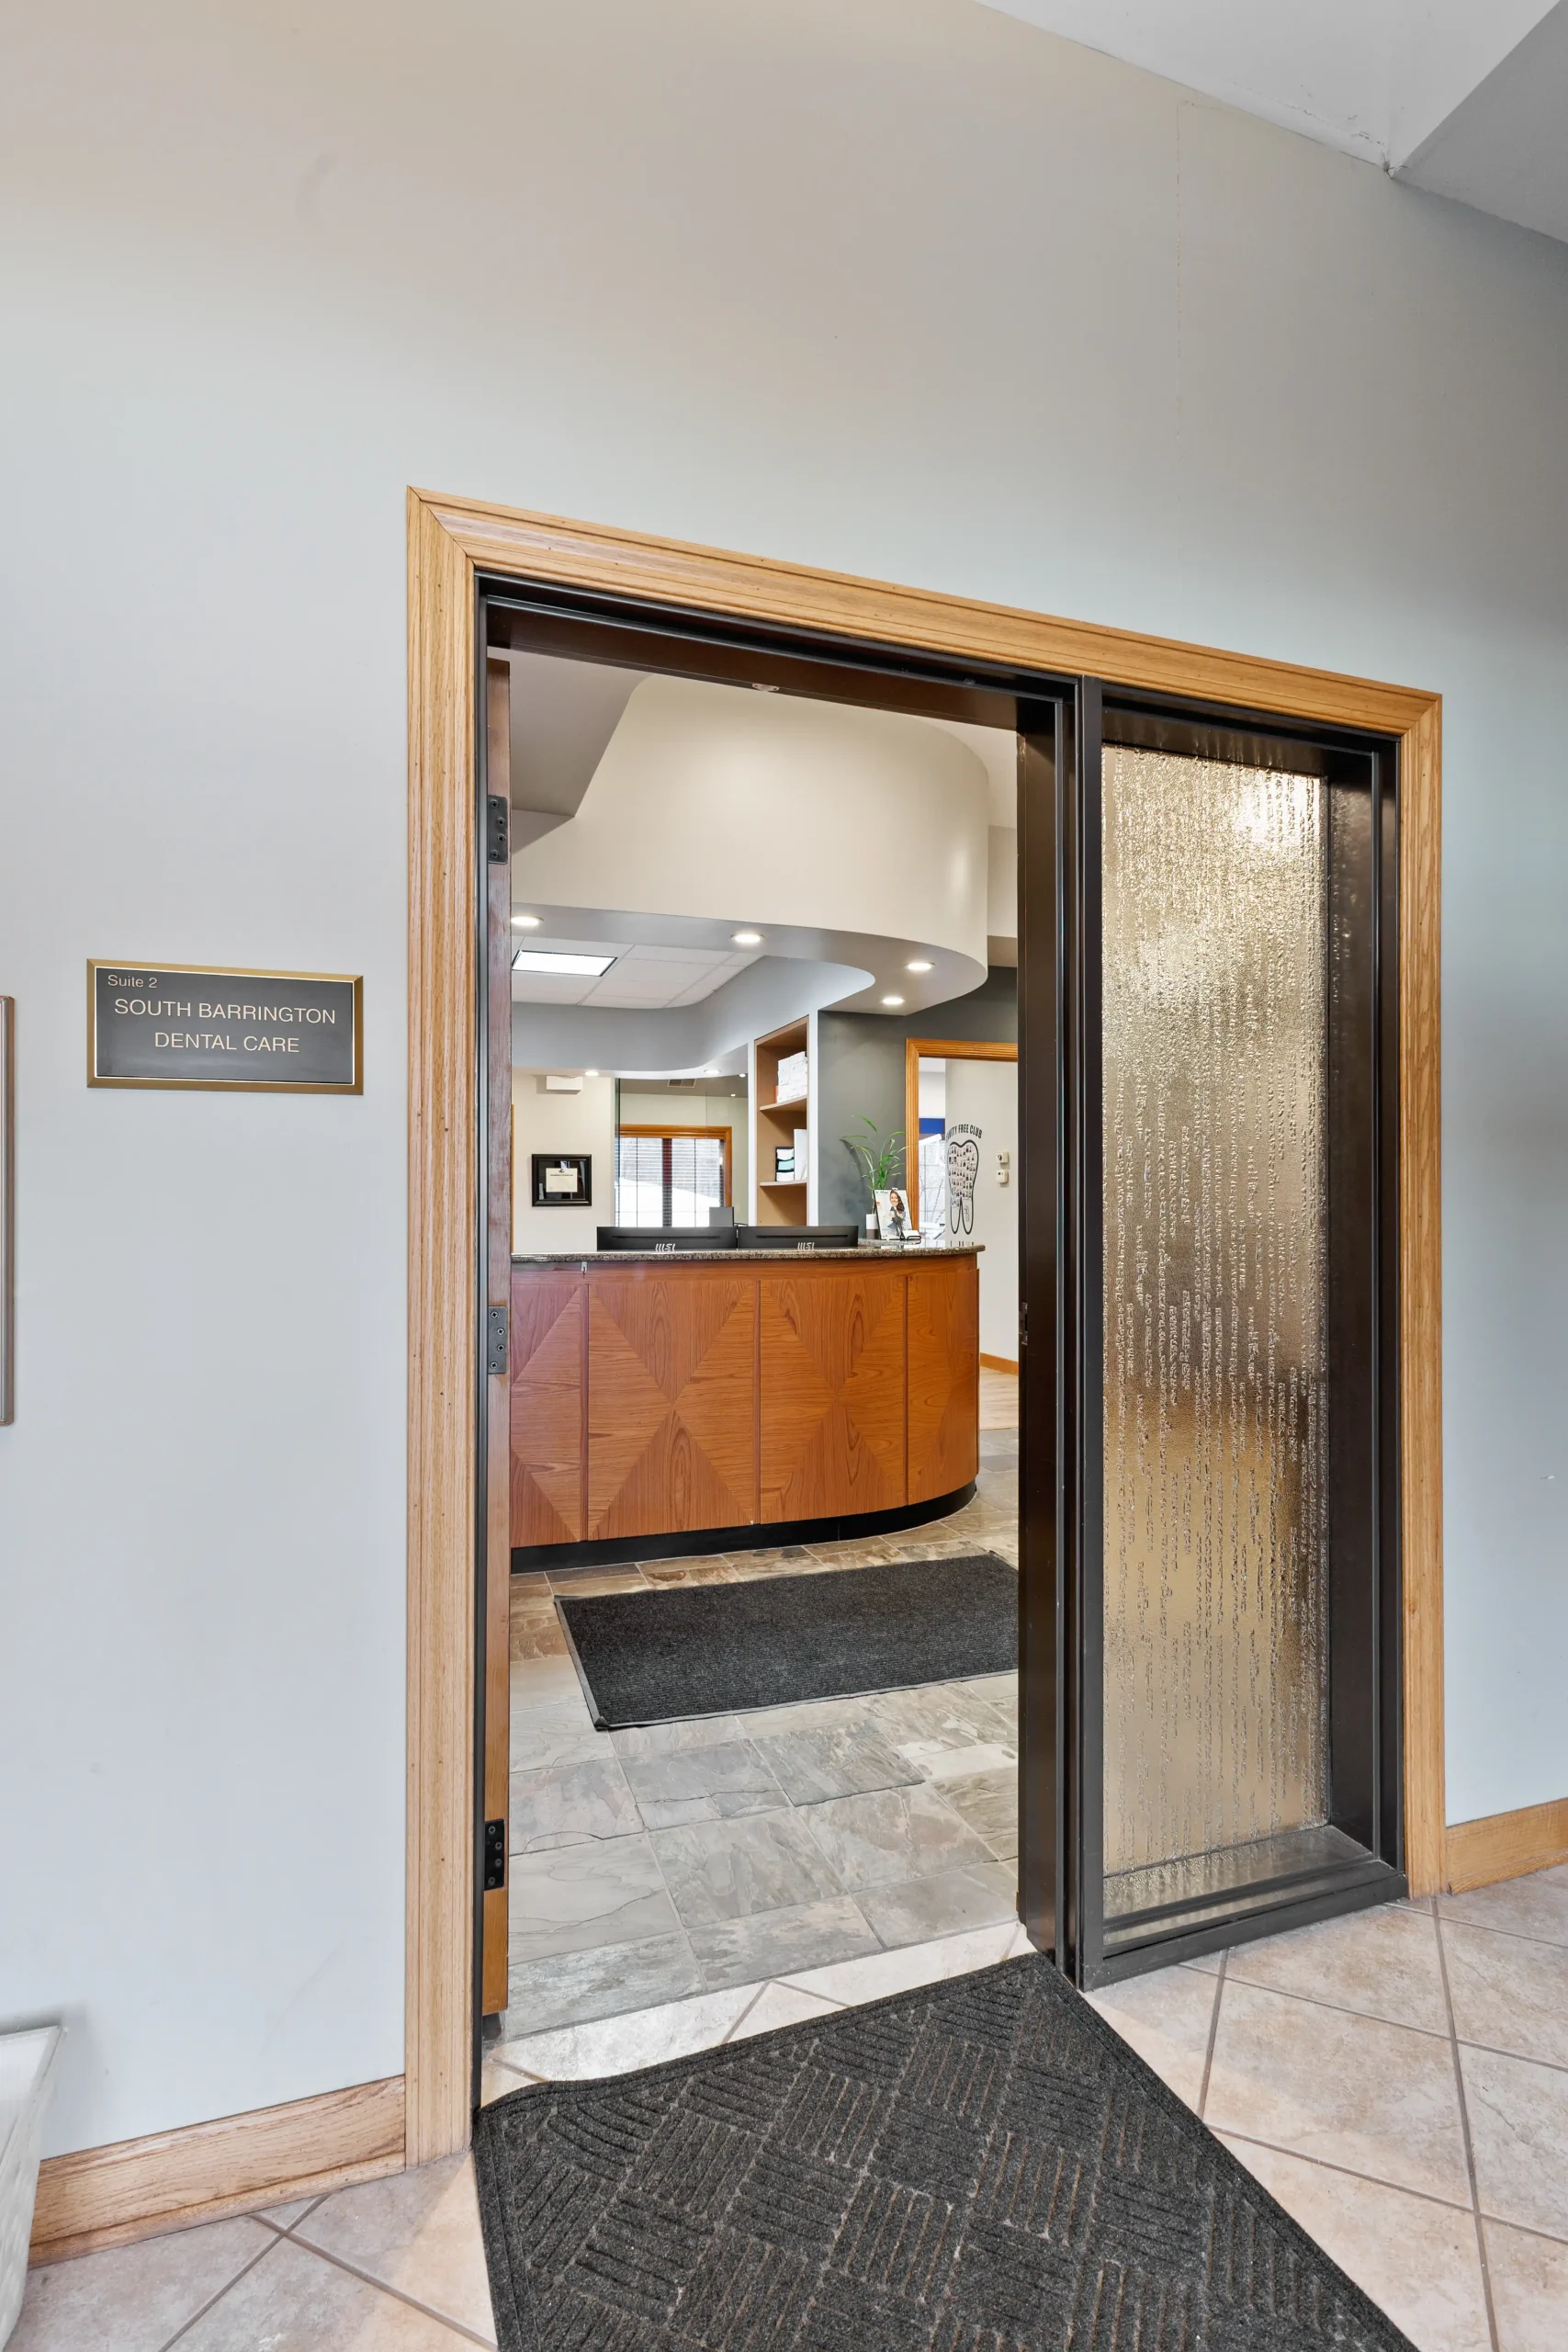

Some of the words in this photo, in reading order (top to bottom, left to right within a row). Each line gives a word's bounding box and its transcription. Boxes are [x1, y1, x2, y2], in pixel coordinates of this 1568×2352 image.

[107, 974, 144, 988] Suite
[149, 977, 158, 989] 2
[114, 998, 191, 1018] SOUTH
[198, 1002, 336, 1024] BARRINGTON
[154, 1032, 237, 1050] DENTAL
[243, 1035, 300, 1053] CARE
[958, 1124, 969, 1133] FREE
[969, 1125, 983, 1139] CLUB
